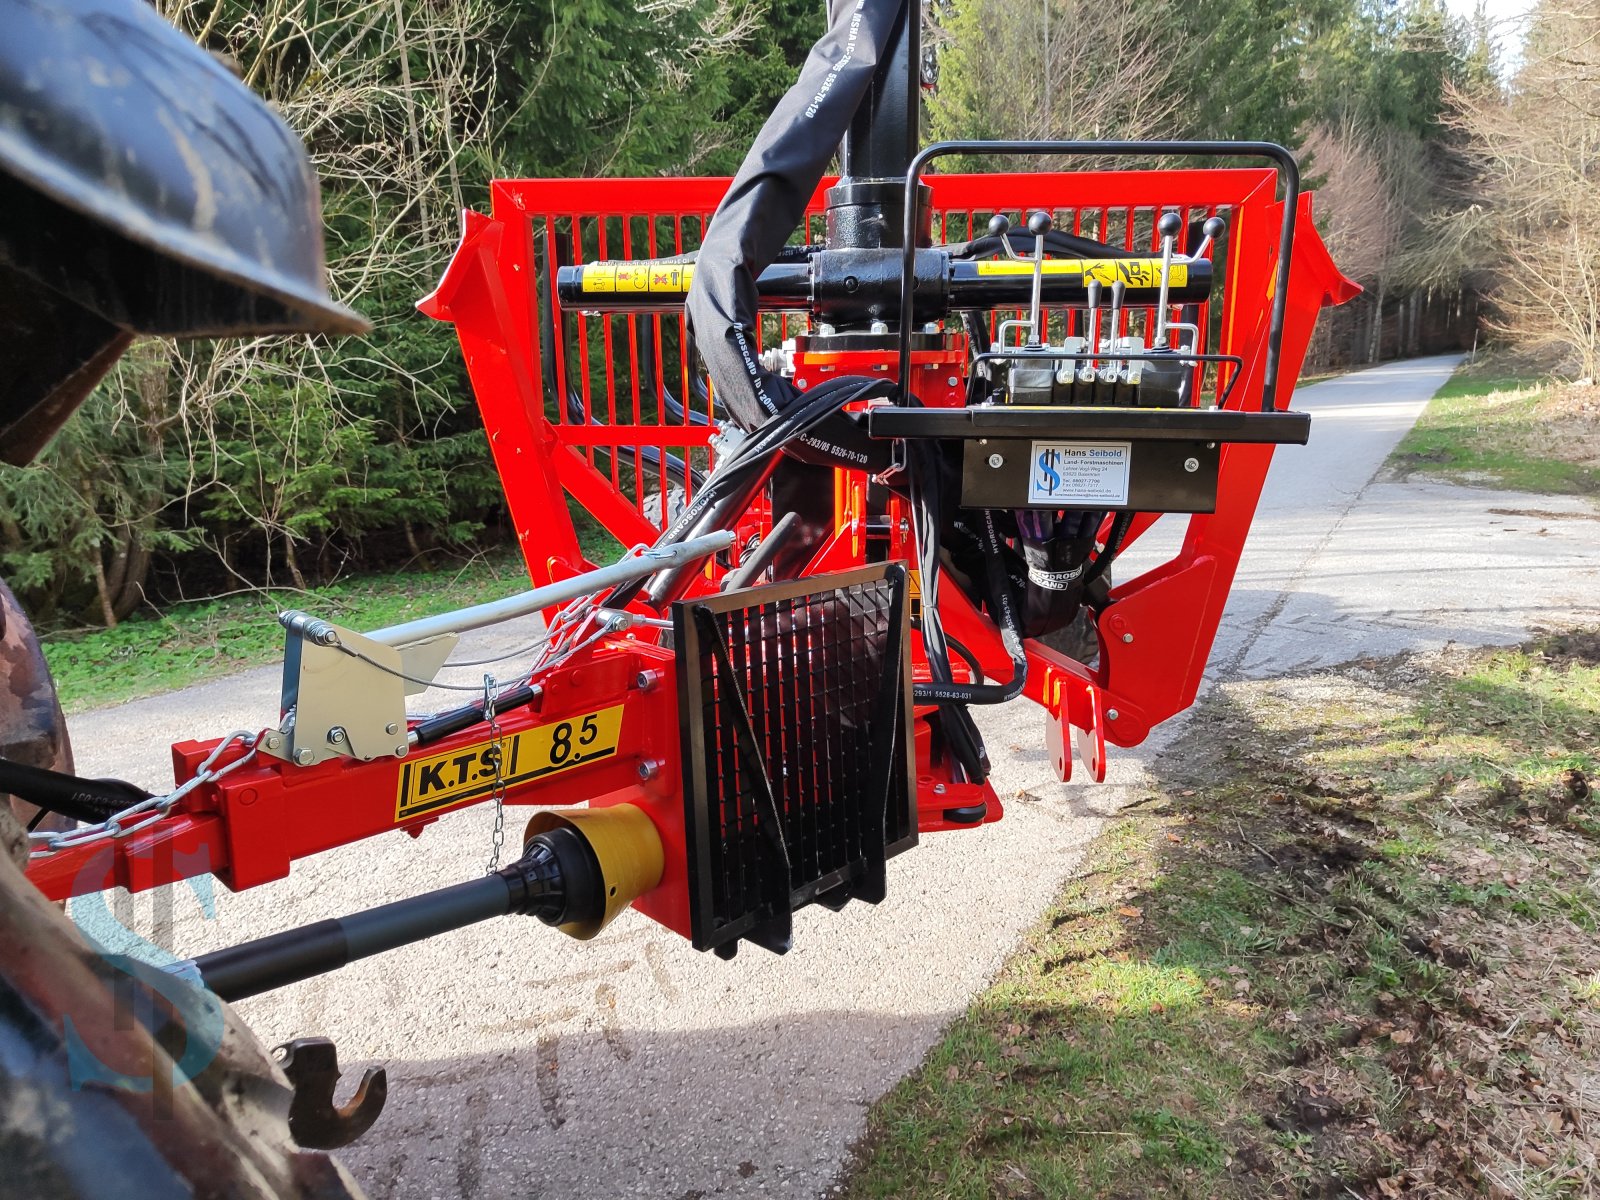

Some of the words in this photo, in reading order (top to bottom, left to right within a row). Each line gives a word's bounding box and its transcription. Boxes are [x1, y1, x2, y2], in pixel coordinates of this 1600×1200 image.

[848, 13, 863, 41] MSHA
[805, 73, 837, 119] 5526-70-120
[753, 378, 762, 388] ID
[798, 432, 830, 451] C-293/05
[830, 445, 868, 464] 5526-70-120
[1064, 448, 1087, 457] Hans
[1089, 449, 1122, 457] Seibold
[984, 509, 999, 554] HYDROSCAN
[549, 713, 598, 765] 8.5
